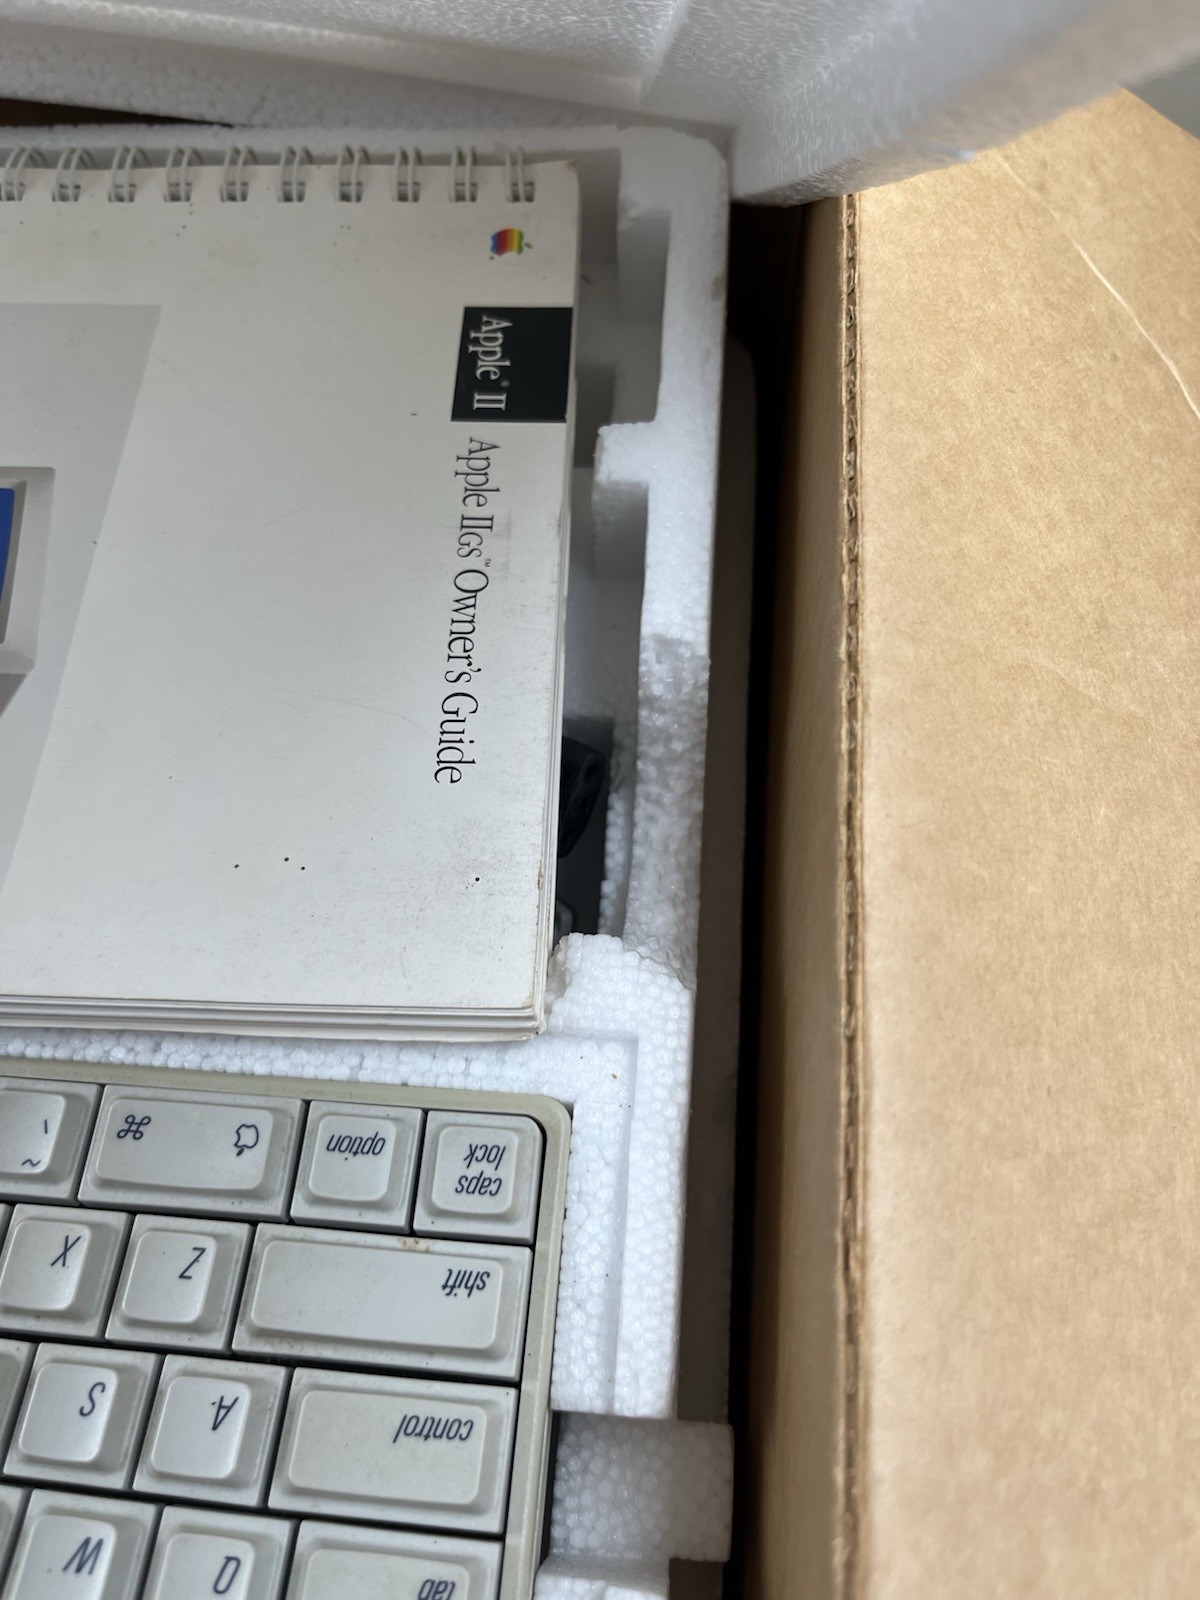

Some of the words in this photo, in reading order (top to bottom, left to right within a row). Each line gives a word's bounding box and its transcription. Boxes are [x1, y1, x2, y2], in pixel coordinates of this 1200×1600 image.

[473, 392, 507, 411] II
[454, 437, 501, 508] Apple
[444, 569, 489, 684] Owner’s
[433, 692, 479, 784] Guide
[325, 1131, 386, 1161] option
[462, 1143, 507, 1169] lock
[454, 1173, 503, 1197] caps
[50, 1234, 82, 1268] X
[178, 1246, 207, 1281] Z
[440, 1268, 491, 1299] shift
[78, 1381, 106, 1418] S
[210, 1394, 240, 1432] A
[392, 1414, 474, 1445] control
[61, 1536, 104, 1575] W
